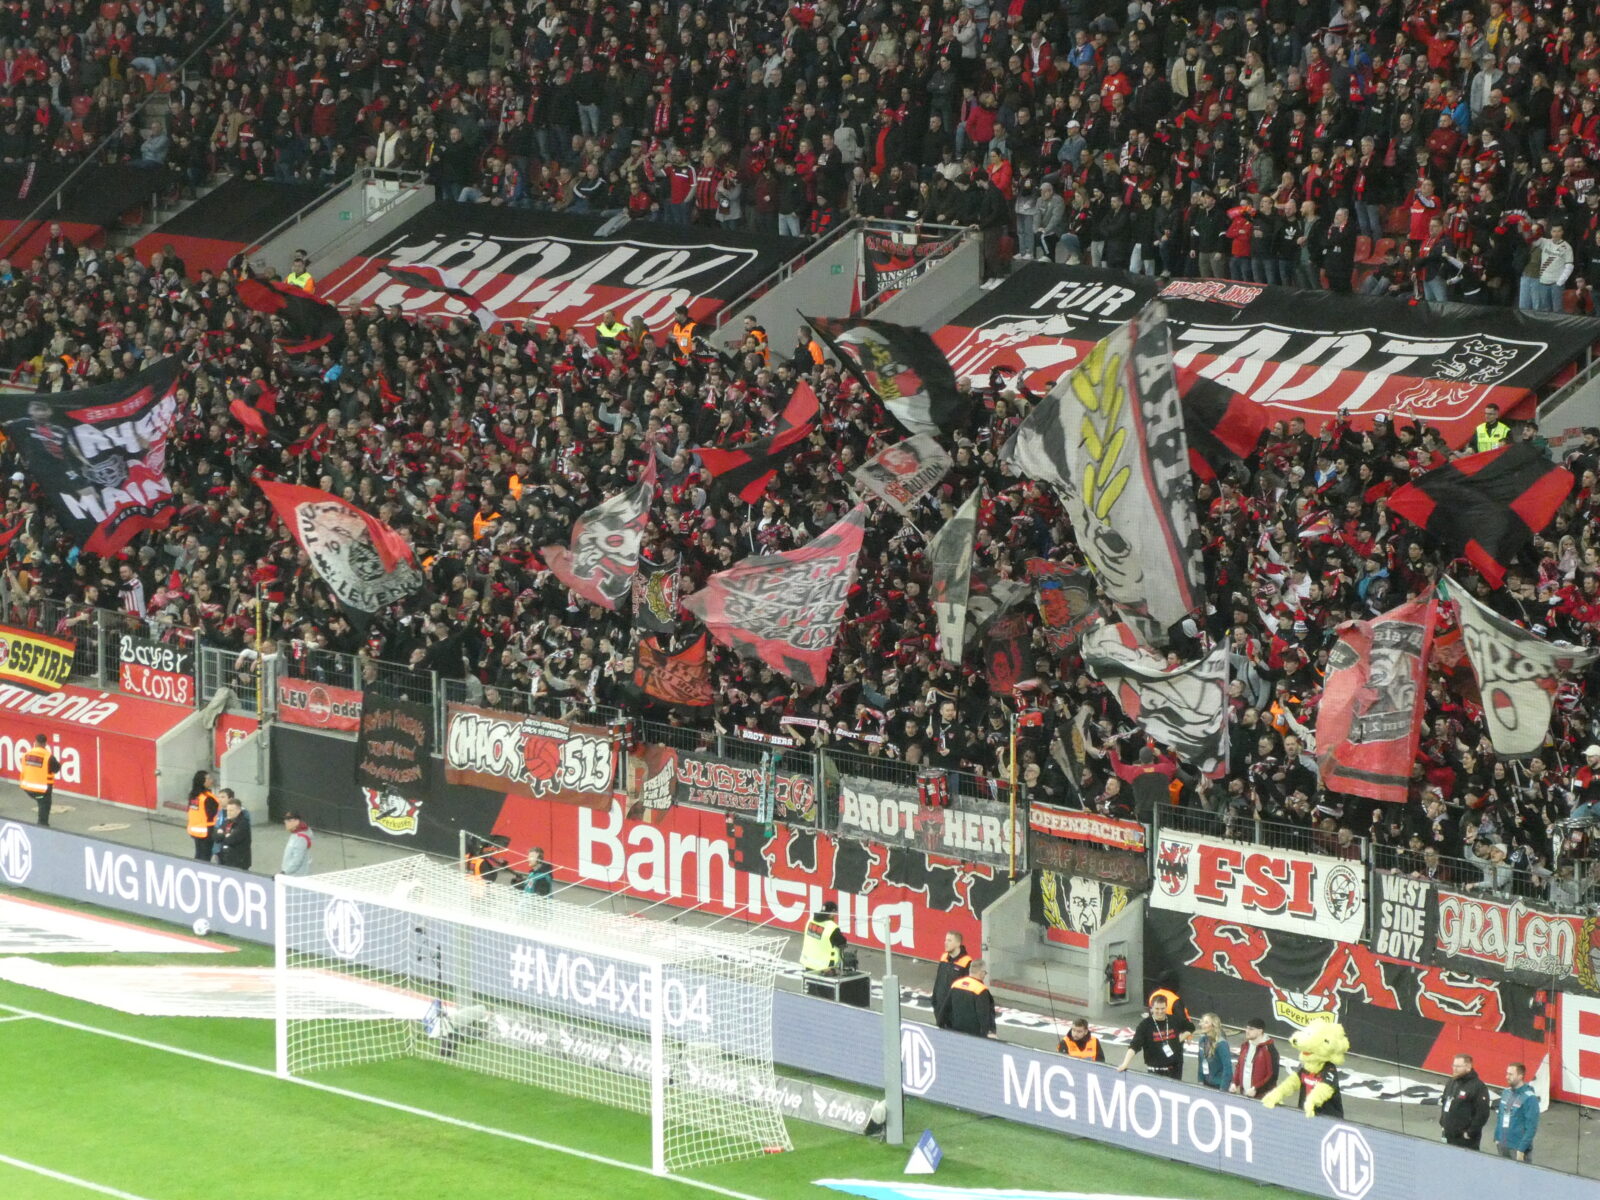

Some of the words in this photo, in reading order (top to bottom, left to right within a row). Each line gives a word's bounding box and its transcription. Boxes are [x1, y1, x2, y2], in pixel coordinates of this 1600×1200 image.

[1030, 280, 1136, 316] FÜR
[1090, 328, 1457, 410] TADT
[120, 635, 188, 673] Bayer
[563, 734, 612, 792] 513
[842, 787, 919, 840] BROT
[943, 807, 1022, 855] HERS
[85, 846, 139, 900] MG
[146, 855, 268, 930] MOTOR
[1194, 844, 1316, 918] FSI
[1381, 874, 1431, 908] WEST
[328, 900, 362, 954] MG
[1376, 928, 1424, 962] BOYZ
[1381, 901, 1426, 937] SIDE
[827, 1099, 866, 1125] trive
[1003, 1054, 1077, 1120] MG
[1087, 1074, 1253, 1163] MOTOR
[1326, 1128, 1371, 1194] MG
